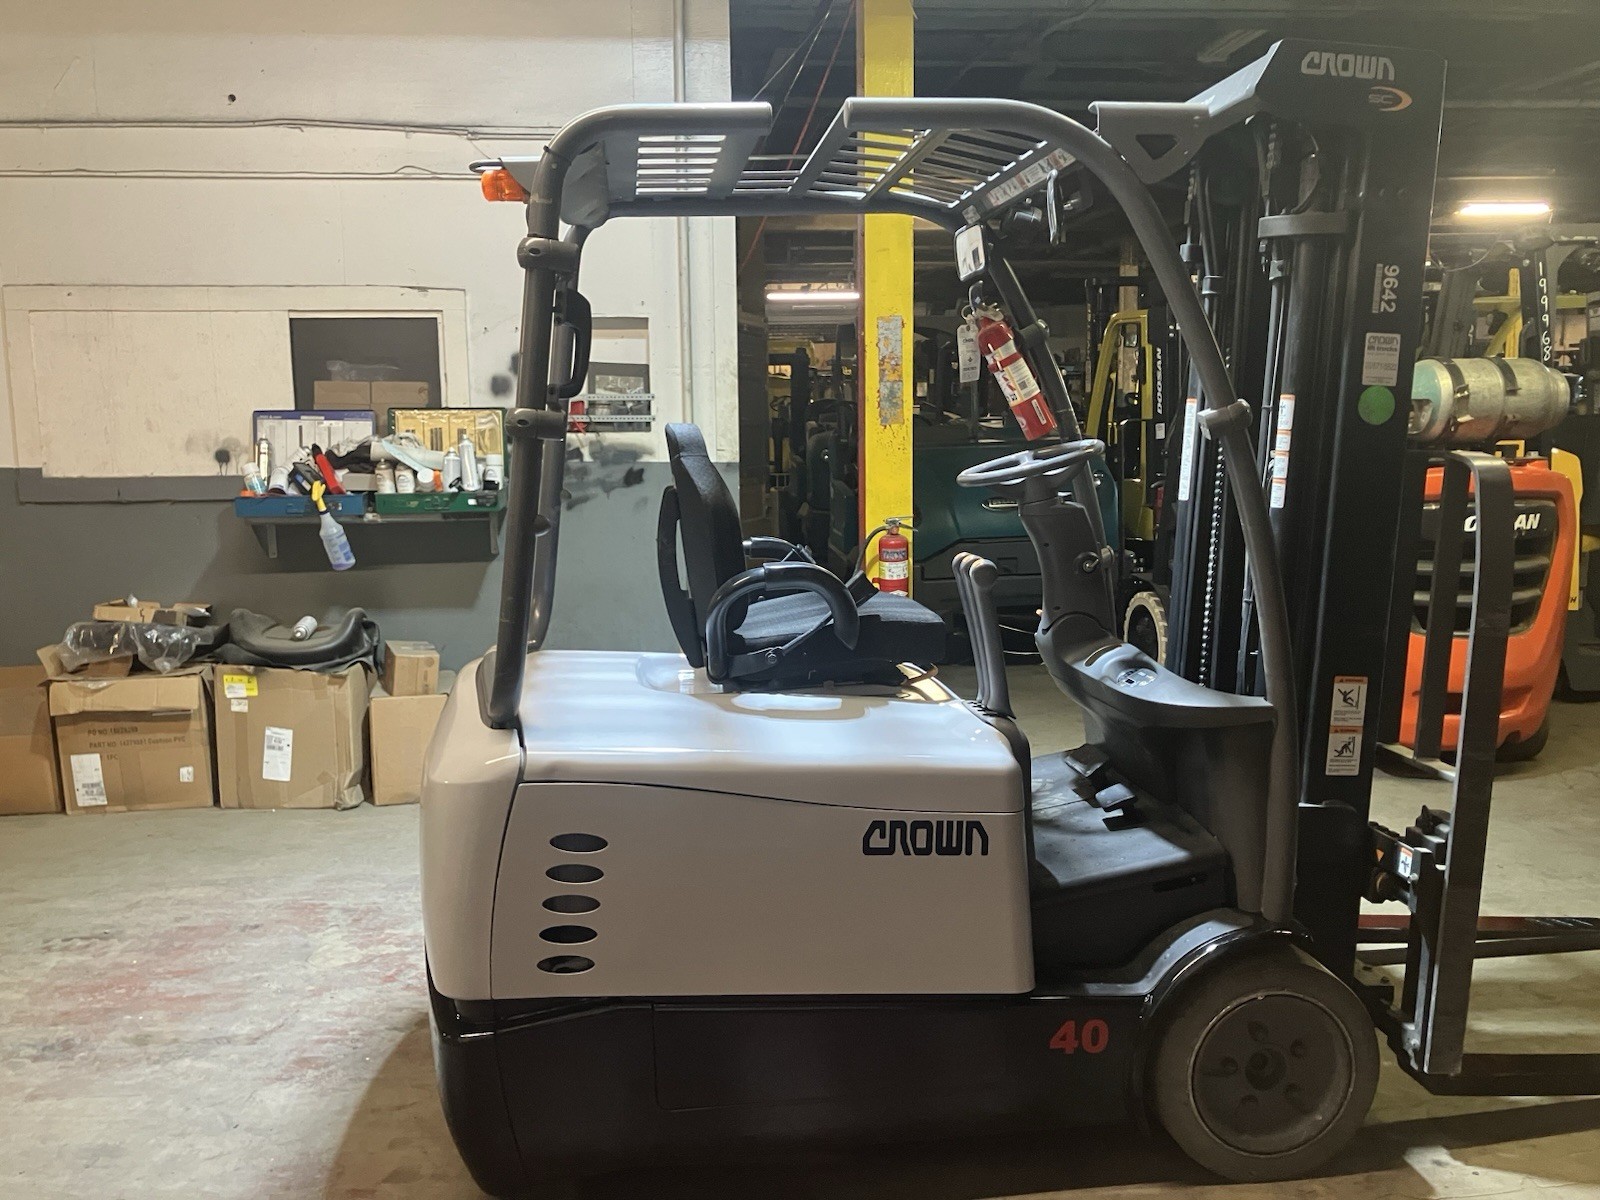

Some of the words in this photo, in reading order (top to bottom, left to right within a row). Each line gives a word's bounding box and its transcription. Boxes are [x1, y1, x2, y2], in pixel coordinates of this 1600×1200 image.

[1300, 51, 1395, 82] CROWN
[1380, 264, 1400, 313] 9642
[862, 820, 989, 856] CROWN
[1050, 1018, 1110, 1055] 40
